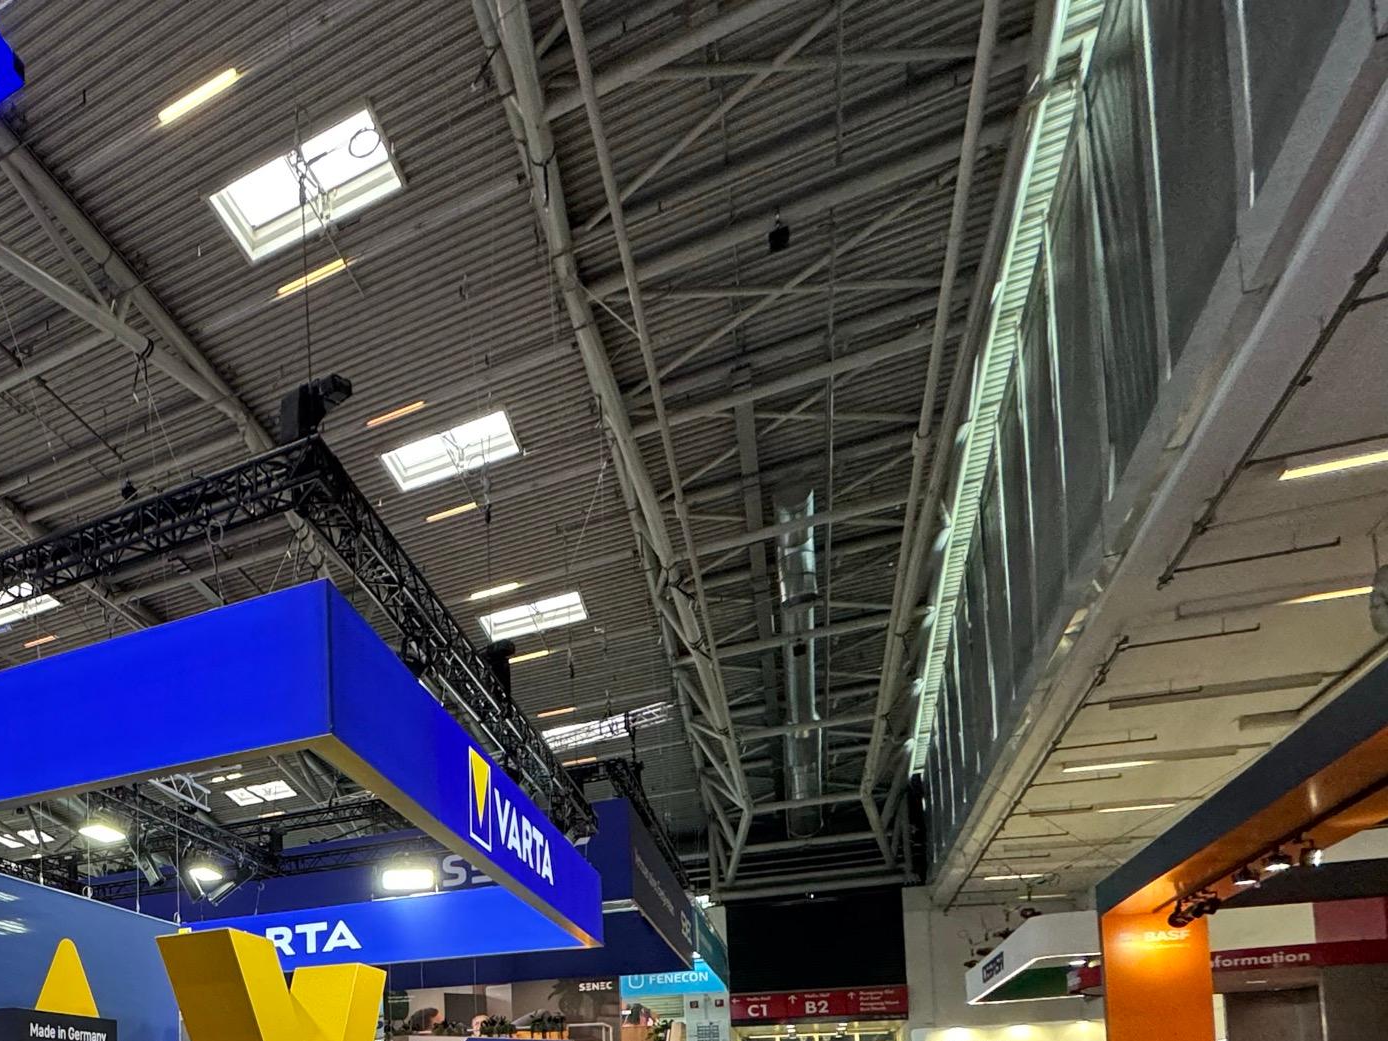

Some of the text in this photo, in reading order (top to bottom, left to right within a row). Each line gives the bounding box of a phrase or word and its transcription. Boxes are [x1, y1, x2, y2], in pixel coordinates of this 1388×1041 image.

[494, 787, 554, 886] VARTA
[265, 920, 362, 956] RTA
[1143, 930, 1190, 942] BASF
[1210, 951, 1311, 968] formation
[648, 971, 709, 985] FENECON
[579, 981, 613, 991] SENEC
[747, 1004, 768, 1017] C1
[804, 1000, 830, 1014] B2
[30, 1022, 55, 1038] Made
[57, 1025, 67, 1040] in
